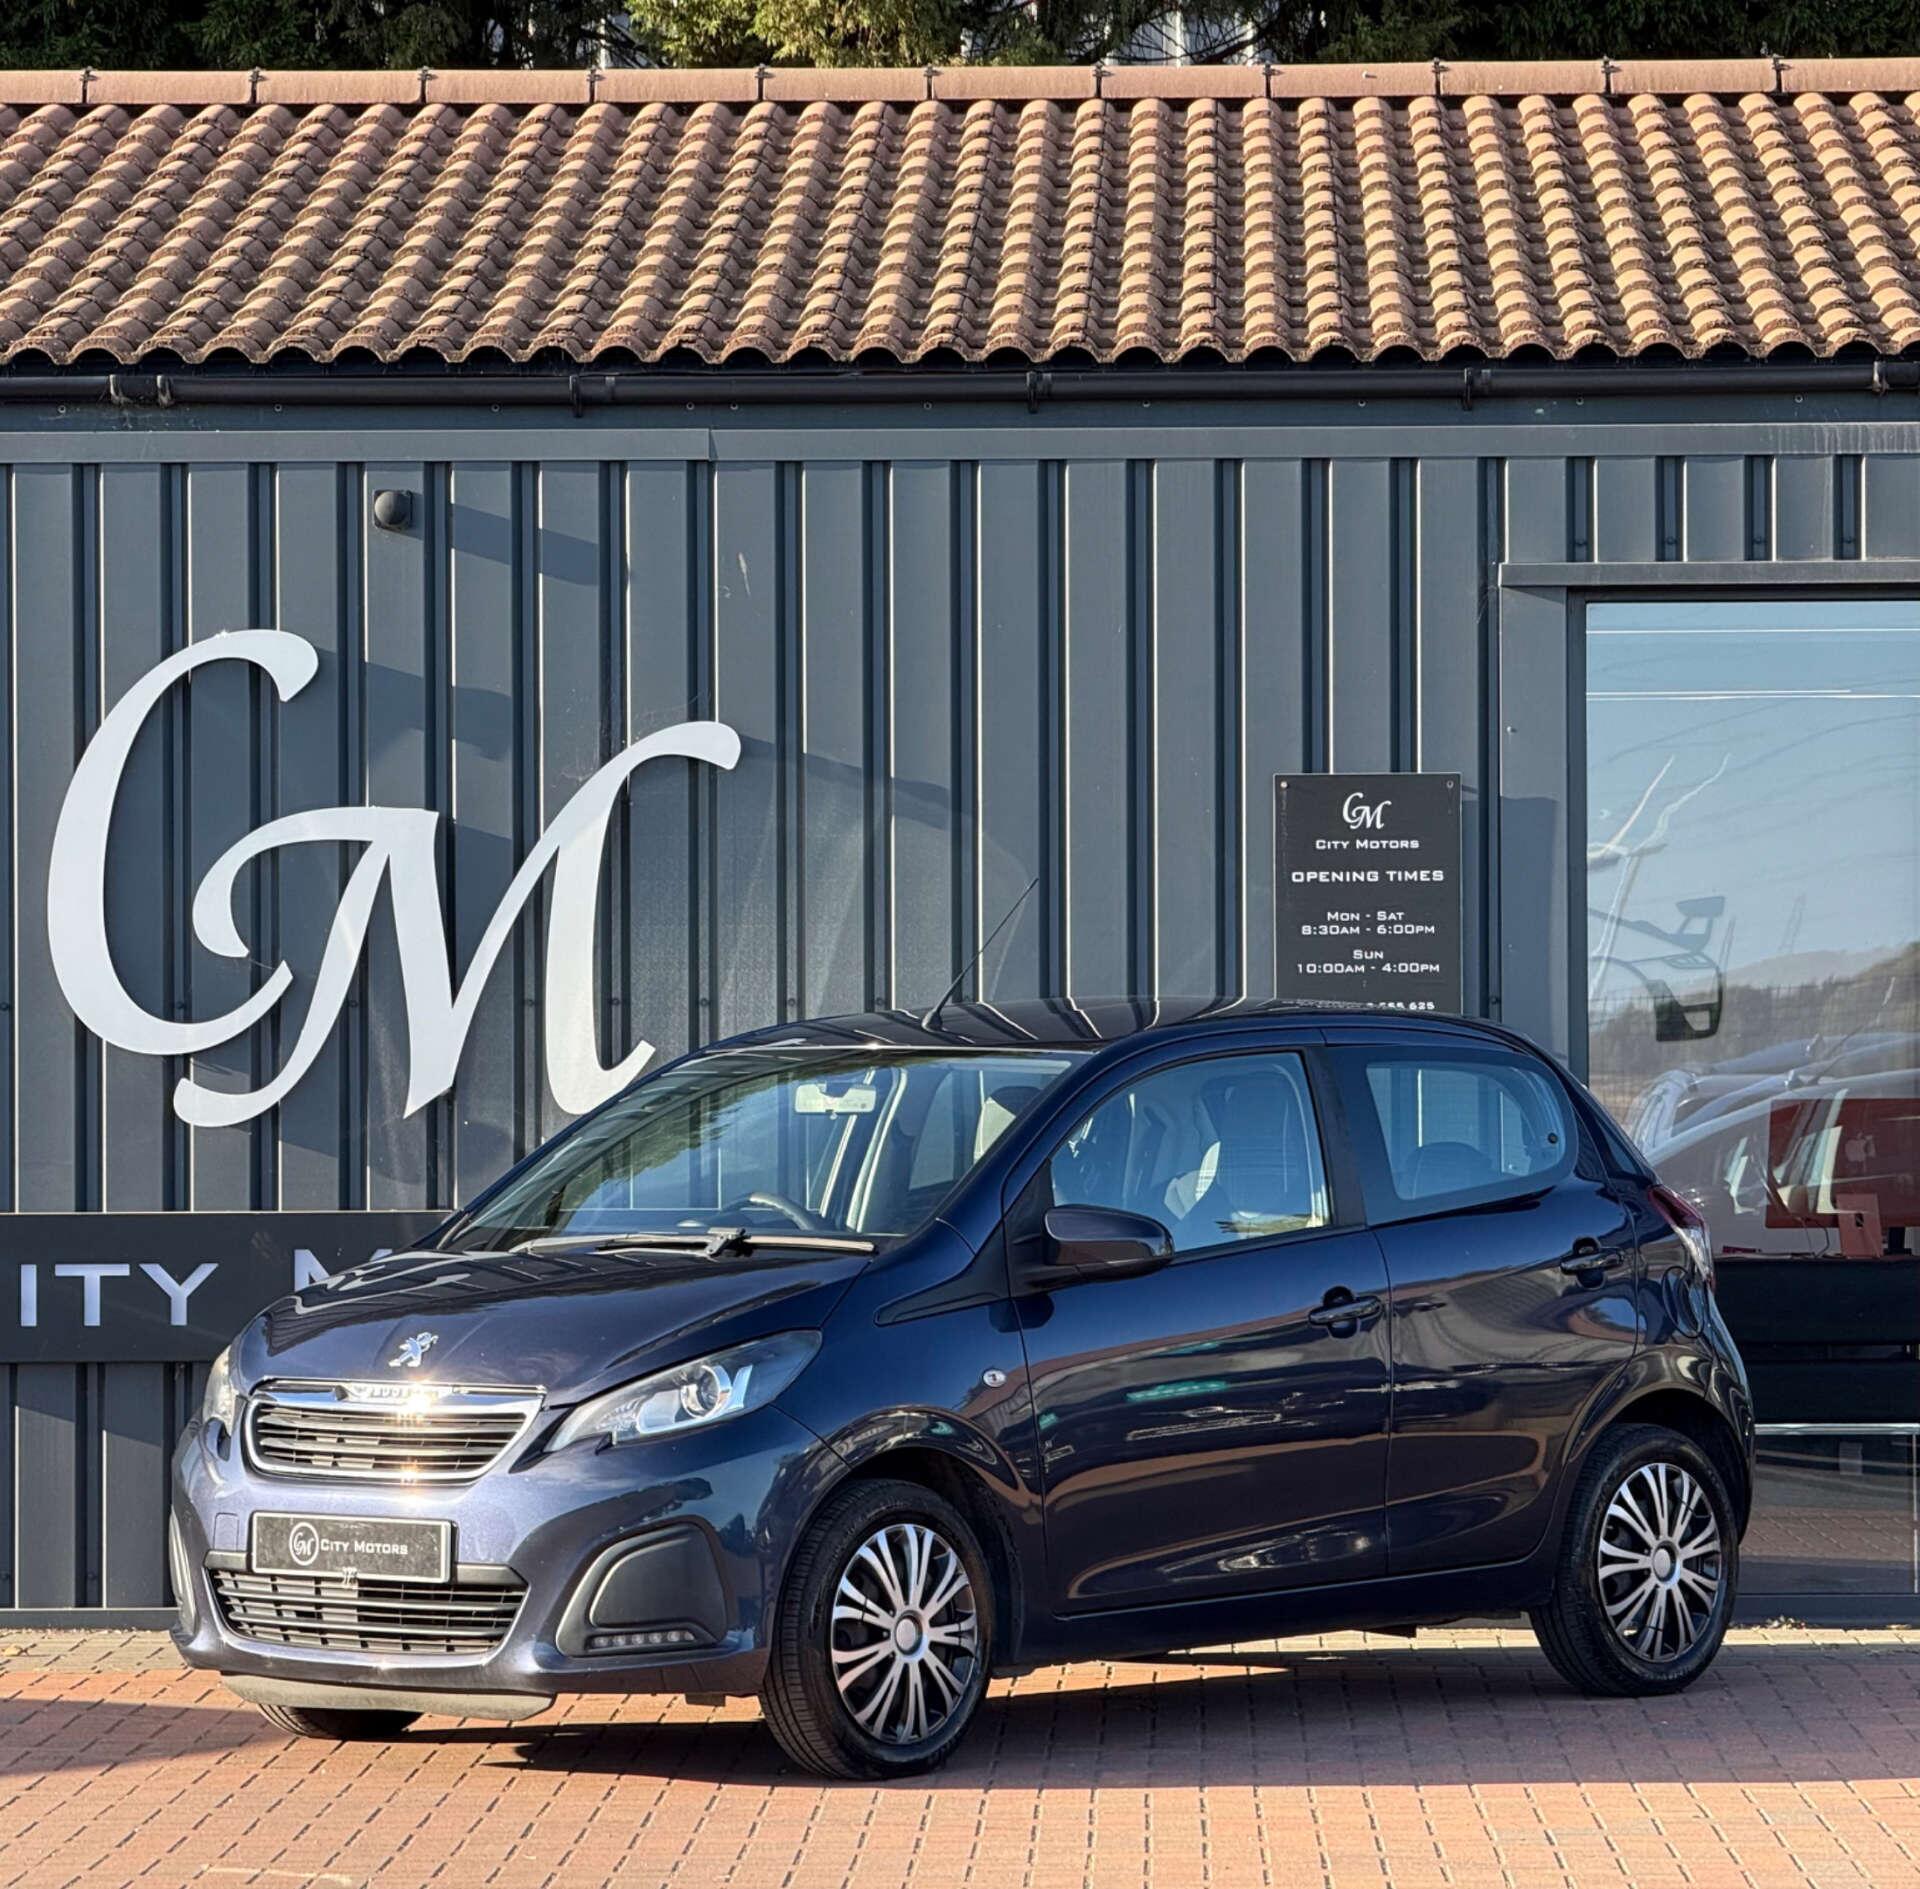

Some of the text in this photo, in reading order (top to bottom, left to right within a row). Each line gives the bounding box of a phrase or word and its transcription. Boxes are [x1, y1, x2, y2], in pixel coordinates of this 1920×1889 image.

[1315, 838, 1420, 850] CITY MOTORS
[1291, 870, 1444, 883] OPENING TIMES
[1327, 911, 1360, 921] MON
[1376, 911, 1405, 921] SAT
[1301, 925, 1360, 935] 8:30AM
[1377, 925, 1435, 935] 6:00PM
[1353, 949, 1384, 960] SUN
[1297, 963, 1365, 974] 10:00AM
[1382, 962, 1440, 973] 4:00PM
[320, 1538, 349, 1552] CITY
[354, 1540, 408, 1555] MOTORS
